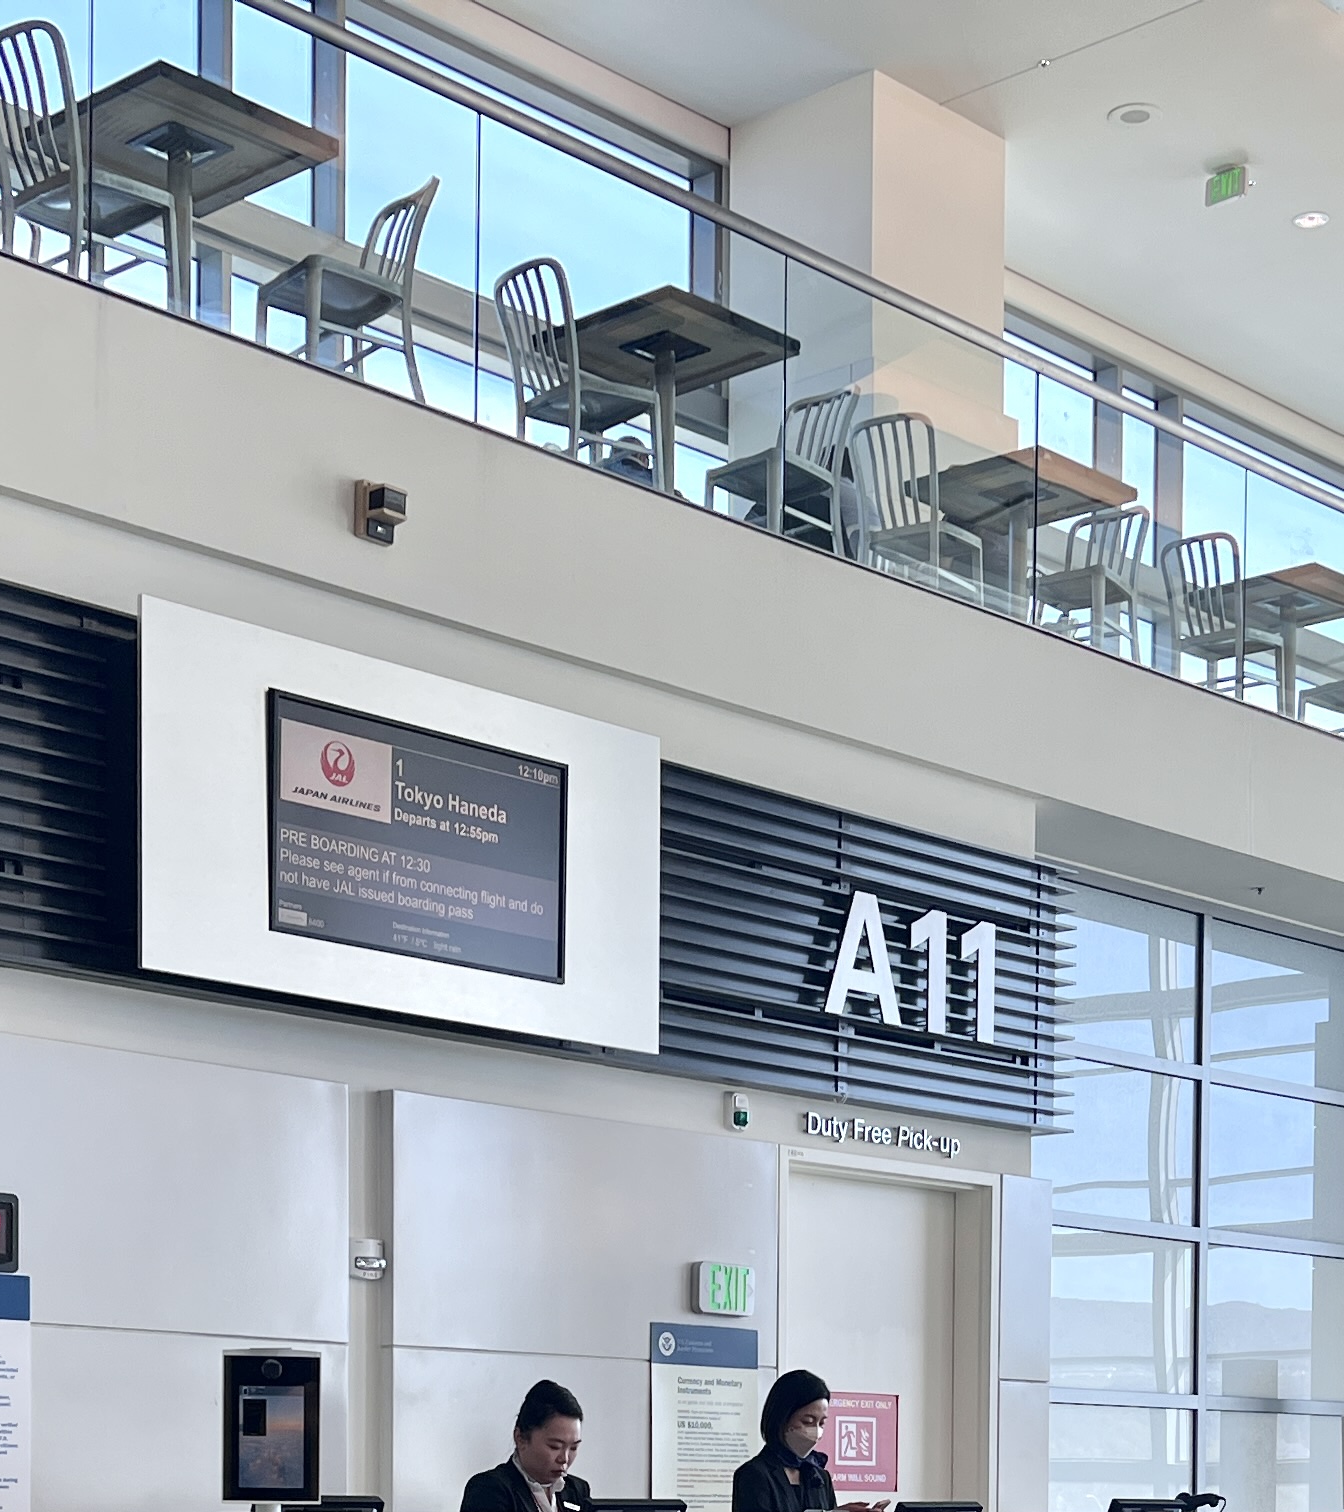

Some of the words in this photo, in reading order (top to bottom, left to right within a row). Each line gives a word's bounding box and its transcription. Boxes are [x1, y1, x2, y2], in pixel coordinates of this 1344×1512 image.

[329, 772, 349, 784] JAL
[396, 759, 404, 777] 1
[518, 765, 559, 785] 12:10pm
[292, 786, 328, 800] JAPAN
[330, 795, 381, 813] AIRLINES
[394, 780, 444, 811] Tokyo
[448, 793, 507, 824] Haneda
[394, 807, 437, 829] Departs
[440, 820, 450, 832] at
[454, 822, 499, 844] 12:55pm
[280, 828, 308, 847] PRE
[310, 834, 379, 862] BOARDING
[381, 850, 397, 866] AT
[400, 855, 431, 873] 12:30
[280, 848, 321, 869] Please
[323, 861, 345, 874] see
[347, 865, 380, 881] agent
[382, 870, 390, 883] if
[392, 871, 417, 890] from
[420, 879, 478, 905] connecting
[481, 890, 506, 909] flight
[509, 899, 528, 912] and
[530, 901, 544, 916] do
[280, 871, 299, 885] not
[302, 872, 330, 890] have
[333, 879, 356, 896] JAL
[359, 884, 394, 903] issued
[397, 892, 445, 917] boarding
[448, 905, 474, 920] pass
[824, 890, 996, 1044] A11
[807, 1111, 848, 1143] Duty
[854, 1118, 892, 1145] Free
[897, 1126, 961, 1158] Pick-up
[709, 1263, 749, 1312] EXIT
